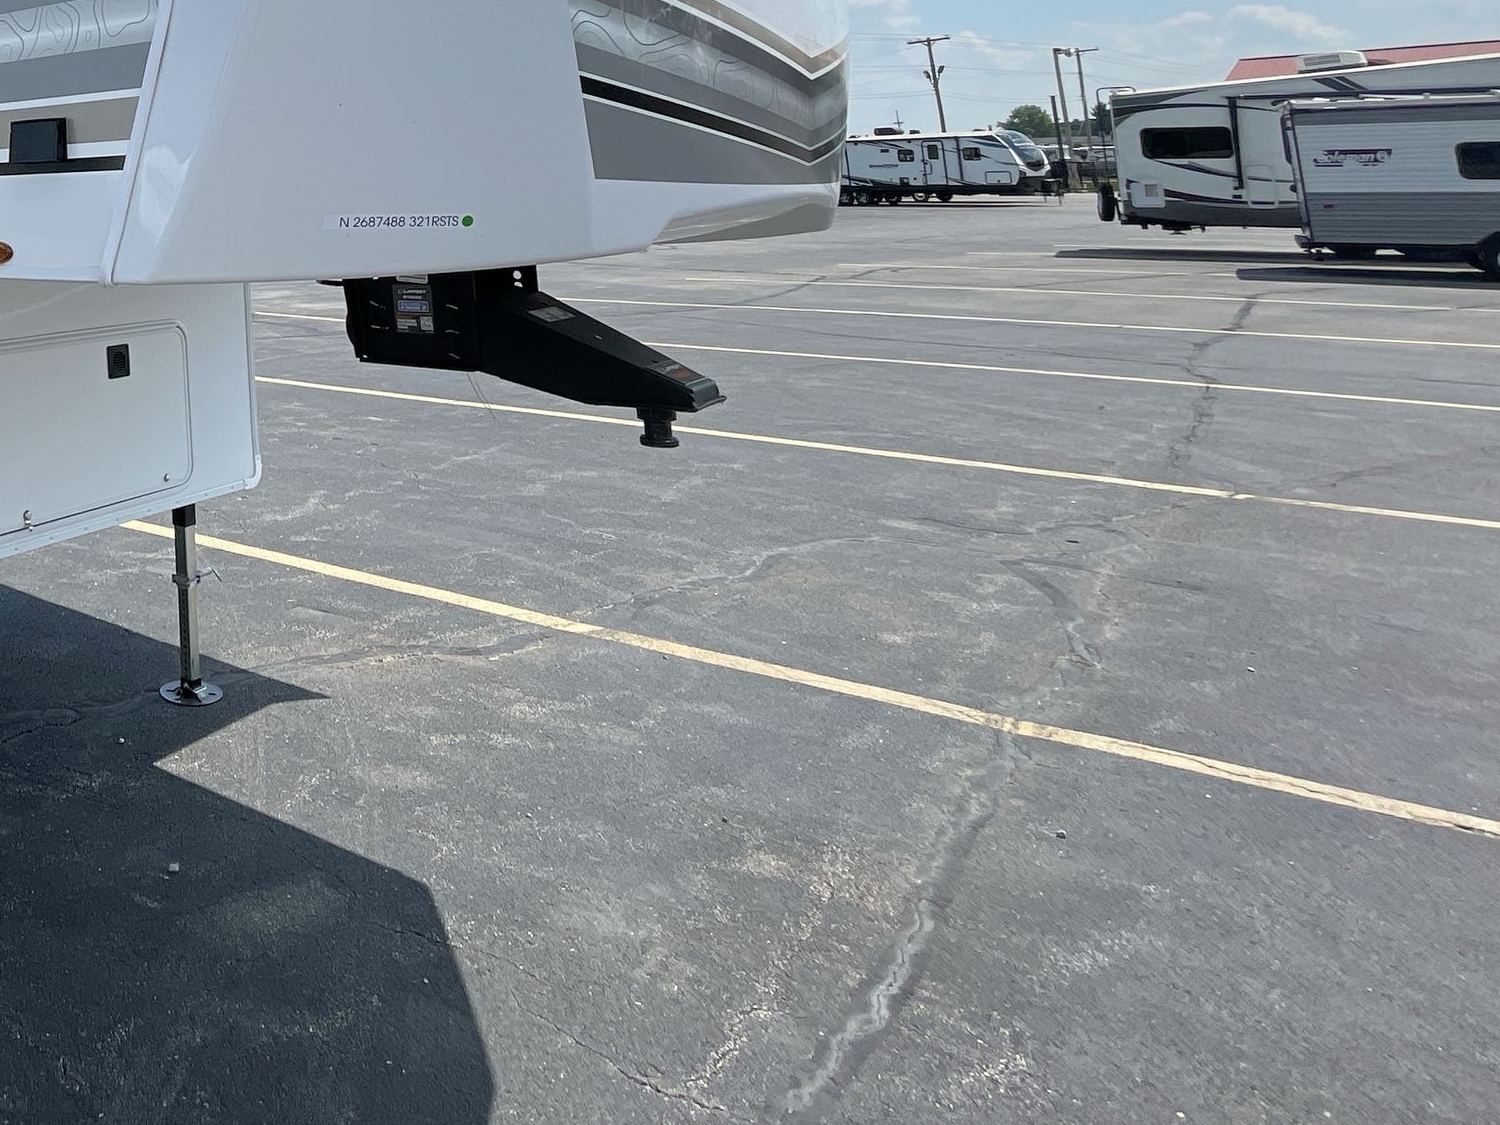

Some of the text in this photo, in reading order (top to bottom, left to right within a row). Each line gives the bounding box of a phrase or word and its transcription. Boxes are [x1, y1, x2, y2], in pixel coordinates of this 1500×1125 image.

[339, 215, 460, 228] N 2687488 321RSTS
